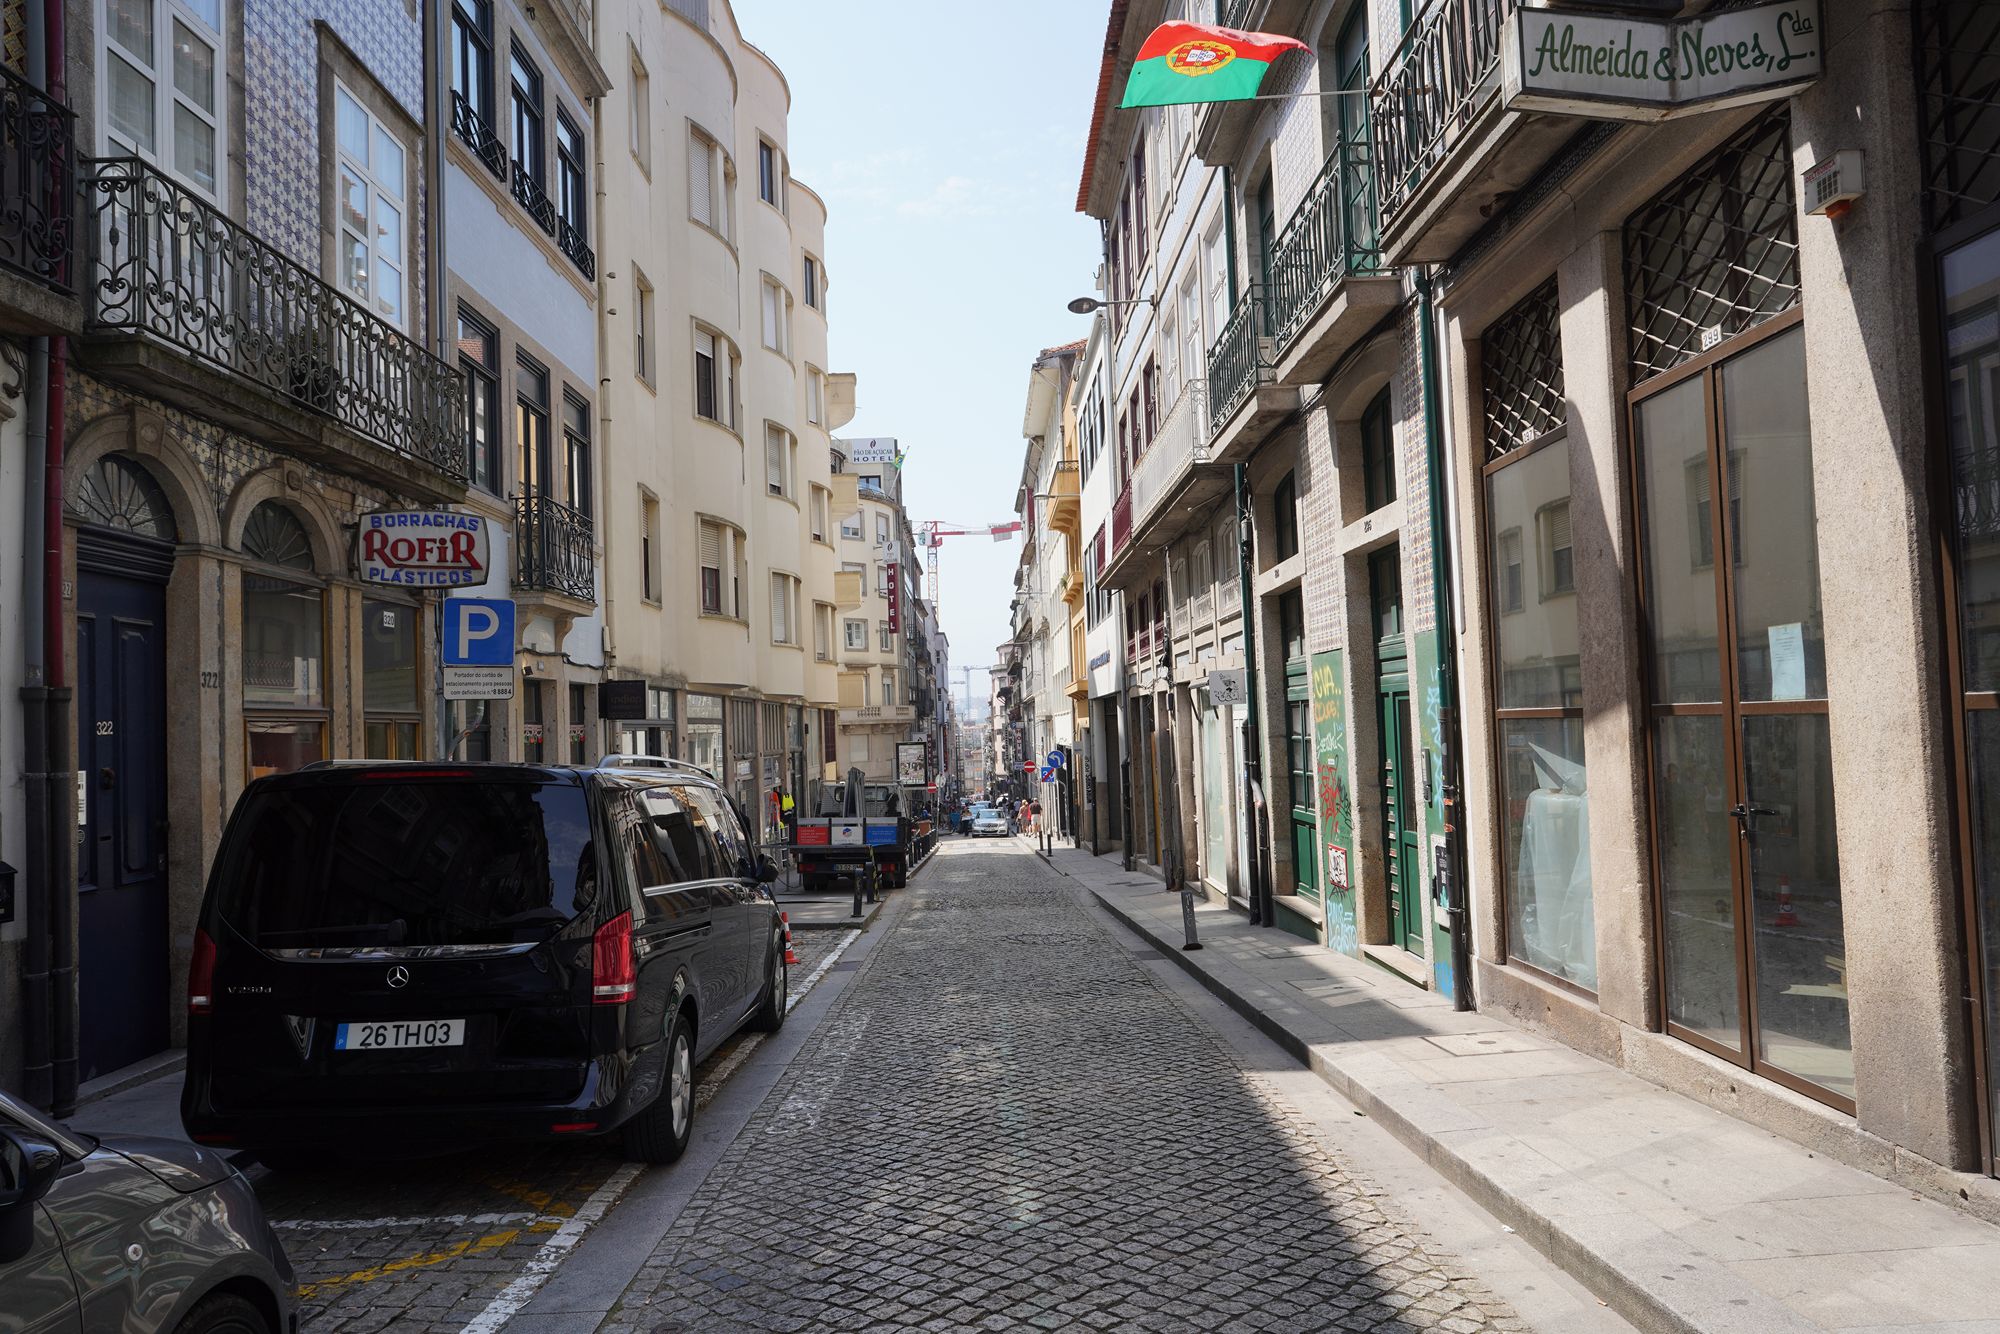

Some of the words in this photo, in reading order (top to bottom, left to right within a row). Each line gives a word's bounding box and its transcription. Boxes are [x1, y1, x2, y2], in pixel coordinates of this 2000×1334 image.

[1528, 22, 1649, 80] Almeida
[1653, 47, 1677, 82] &
[1680, 28, 1776, 81] Neves,
[1703, 328, 1719, 348] 299
[370, 513, 479, 532] BORRACHAS
[368, 566, 473, 585] PLÁSTICOS
[887, 568, 896, 630] HOTEL
[383, 614, 395, 626] 320
[458, 604, 500, 659] P
[201, 671, 218, 689] 322
[96, 721, 113, 736] 322
